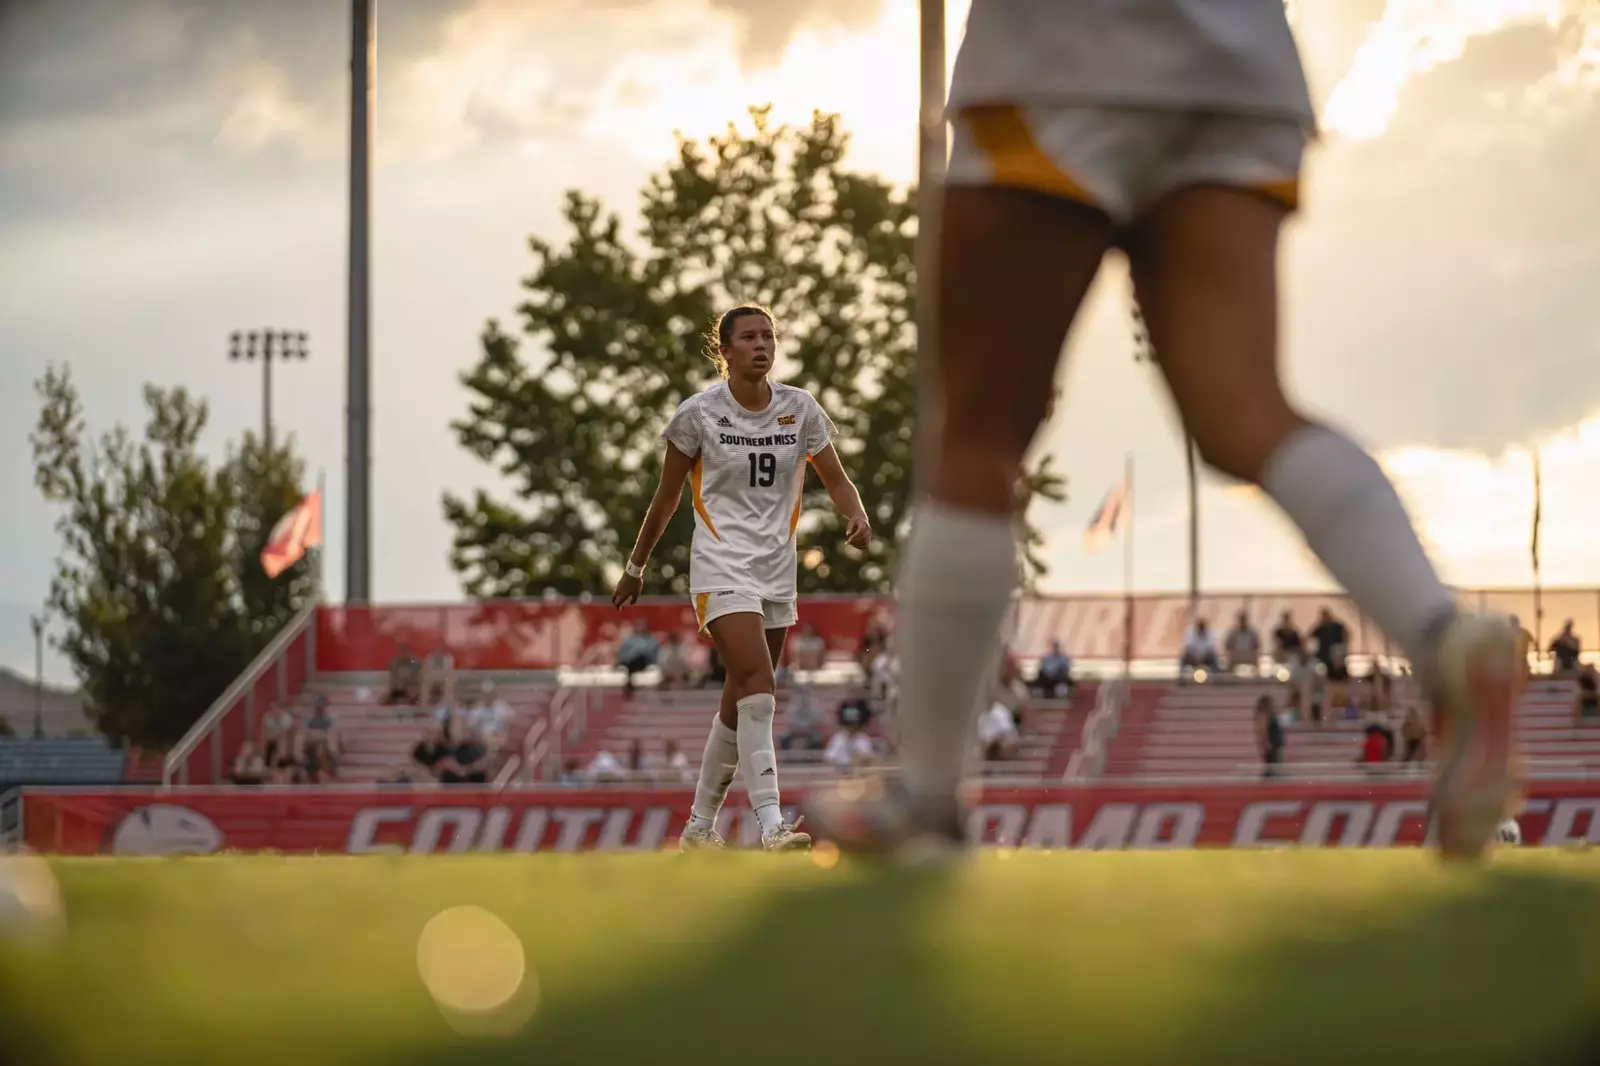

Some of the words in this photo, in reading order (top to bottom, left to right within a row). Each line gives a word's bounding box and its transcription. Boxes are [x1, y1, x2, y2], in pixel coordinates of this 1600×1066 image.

[719, 433, 773, 447] SOUTHERN
[773, 433, 797, 446] MISS
[748, 452, 777, 488] 19
